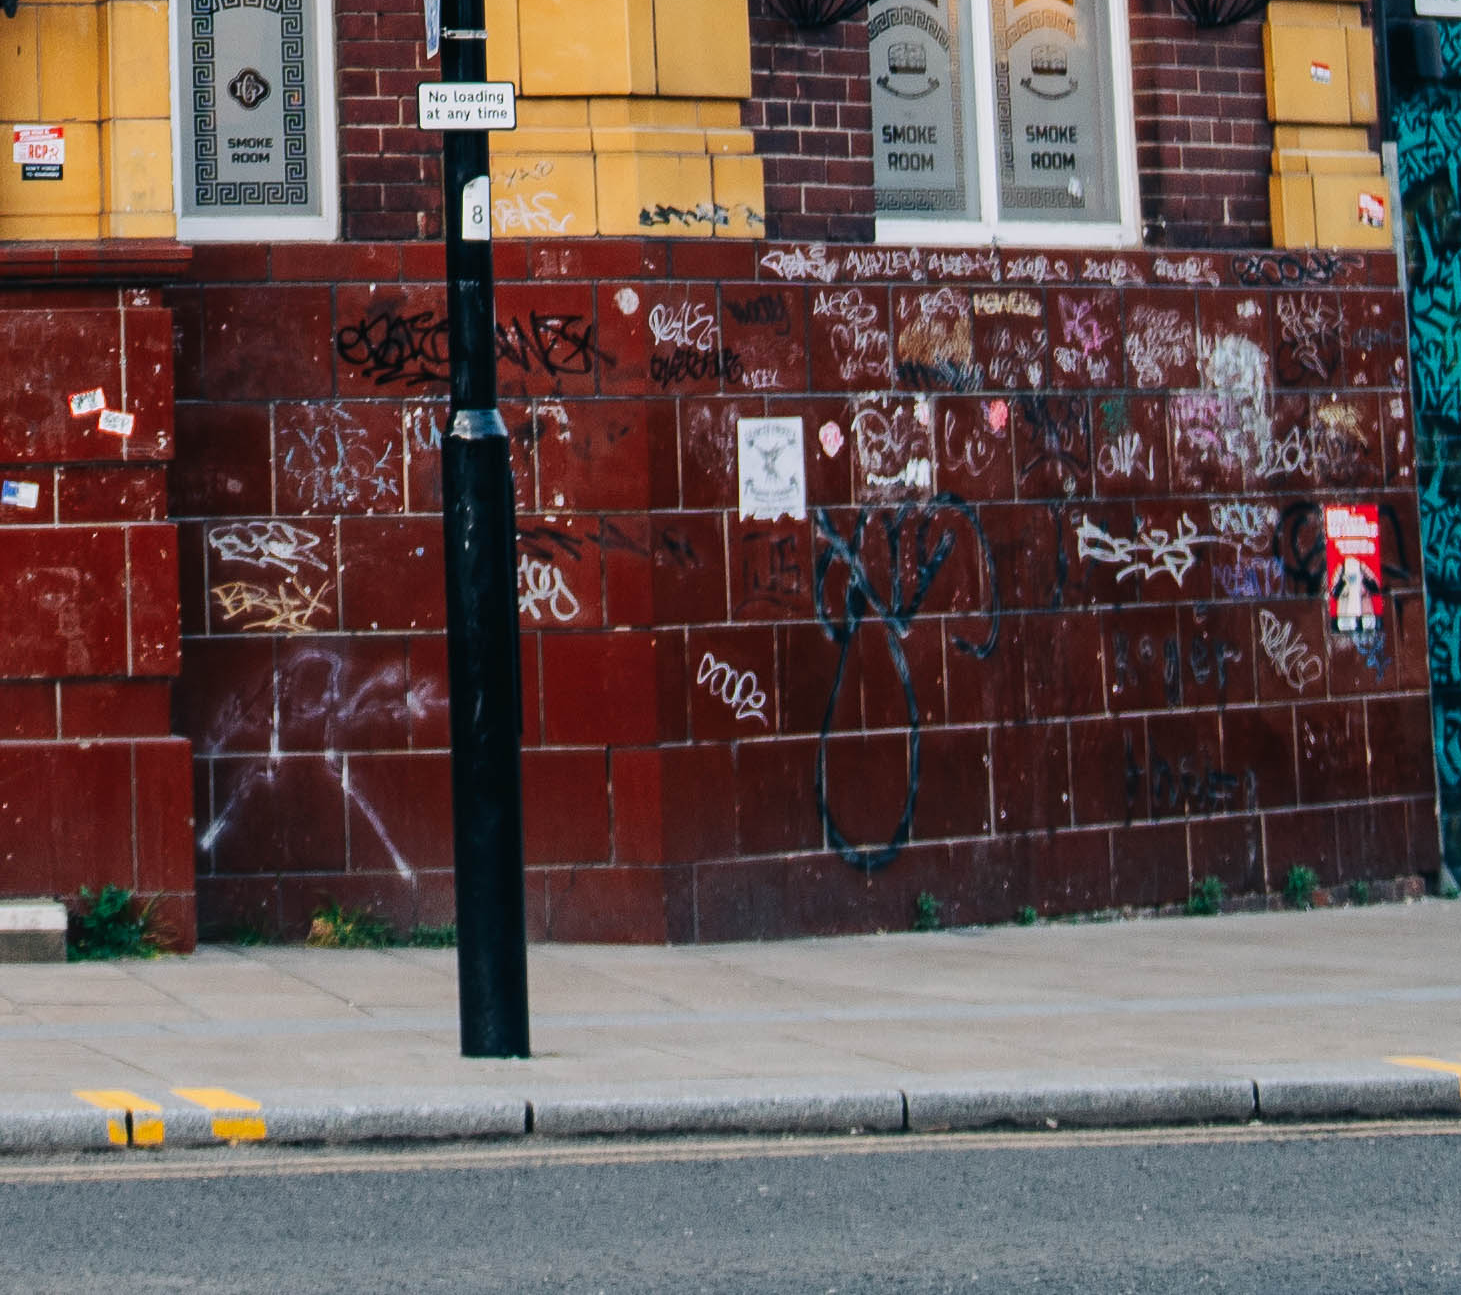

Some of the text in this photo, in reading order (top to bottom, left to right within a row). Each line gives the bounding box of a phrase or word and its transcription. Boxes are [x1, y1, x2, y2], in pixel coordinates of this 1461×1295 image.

[428, 90, 504, 104] No loading
[426, 106, 508, 121] at any time
[228, 137, 273, 149] SMOKE
[882, 124, 937, 145] SMOKE
[1026, 124, 1078, 145] SMOKE
[232, 152, 270, 163] ROOM
[888, 152, 934, 173] ROOM
[1031, 152, 1076, 172] ROOM
